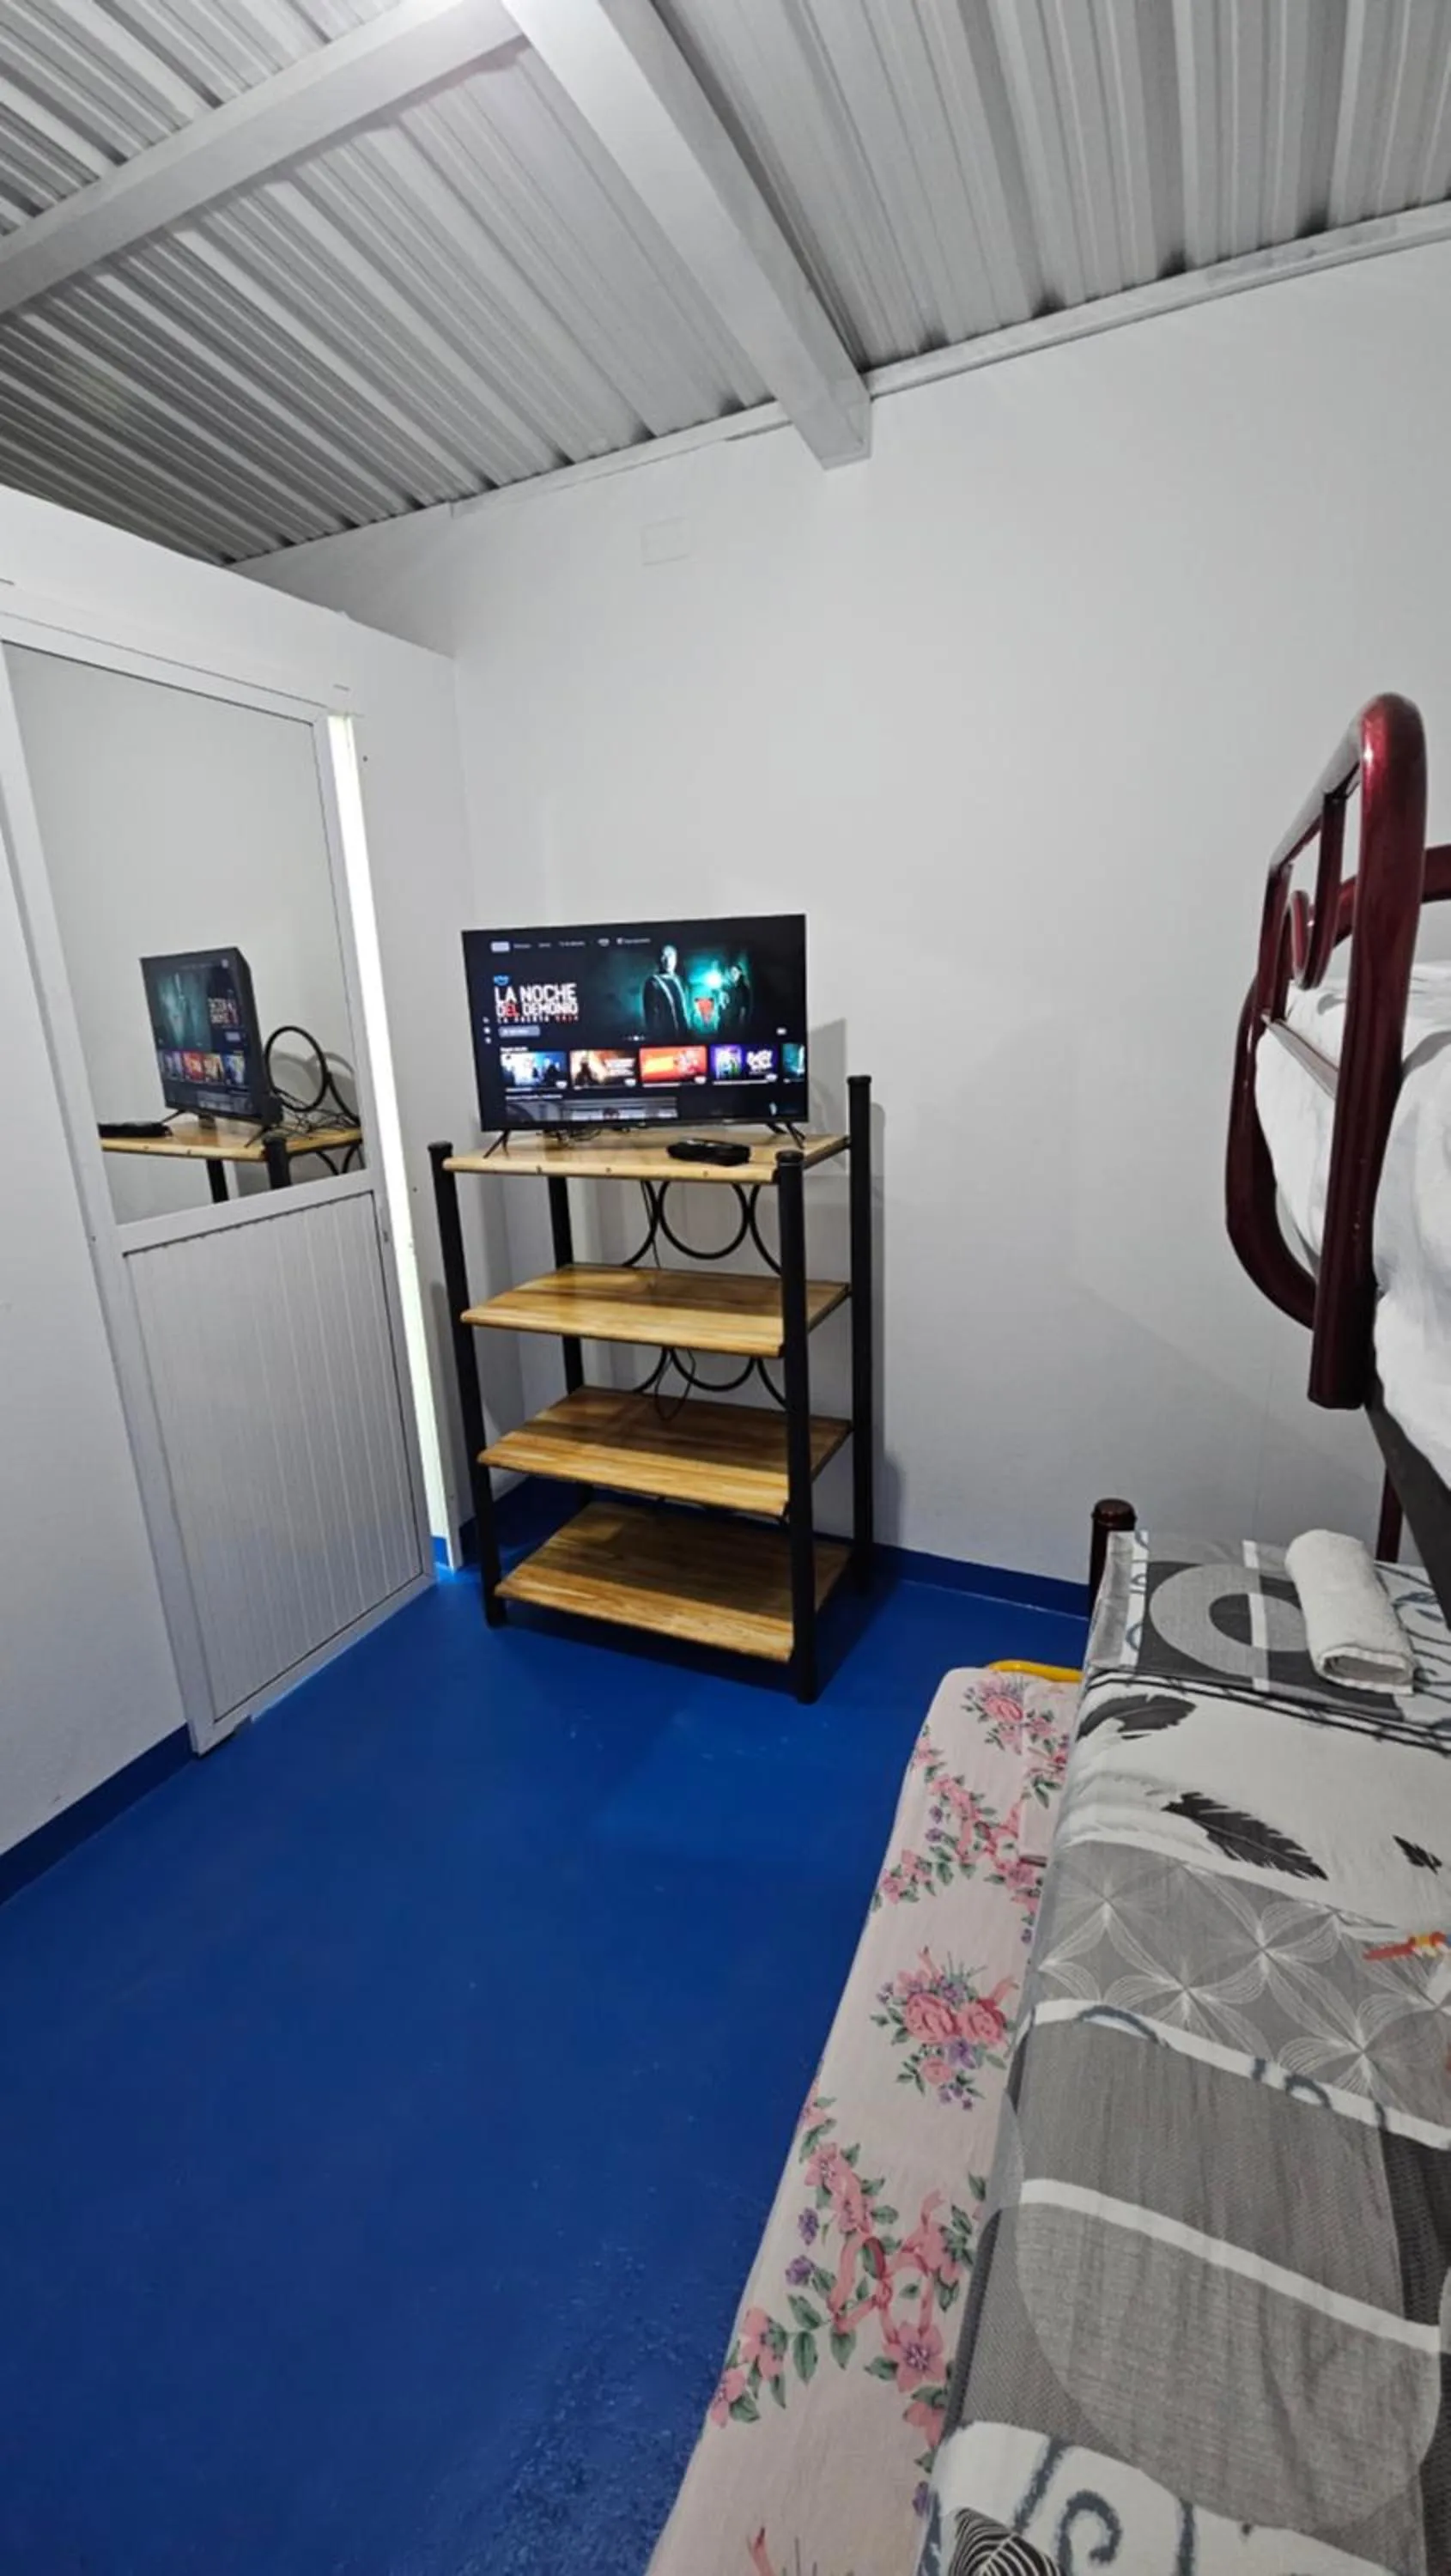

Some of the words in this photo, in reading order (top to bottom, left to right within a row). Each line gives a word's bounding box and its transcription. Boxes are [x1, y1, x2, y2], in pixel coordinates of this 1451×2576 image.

[495, 986, 517, 1002] LA
[519, 983, 577, 1002] NOCHE
[495, 1001, 519, 1017] DEL
[522, 1000, 579, 1017] DEMONIO
